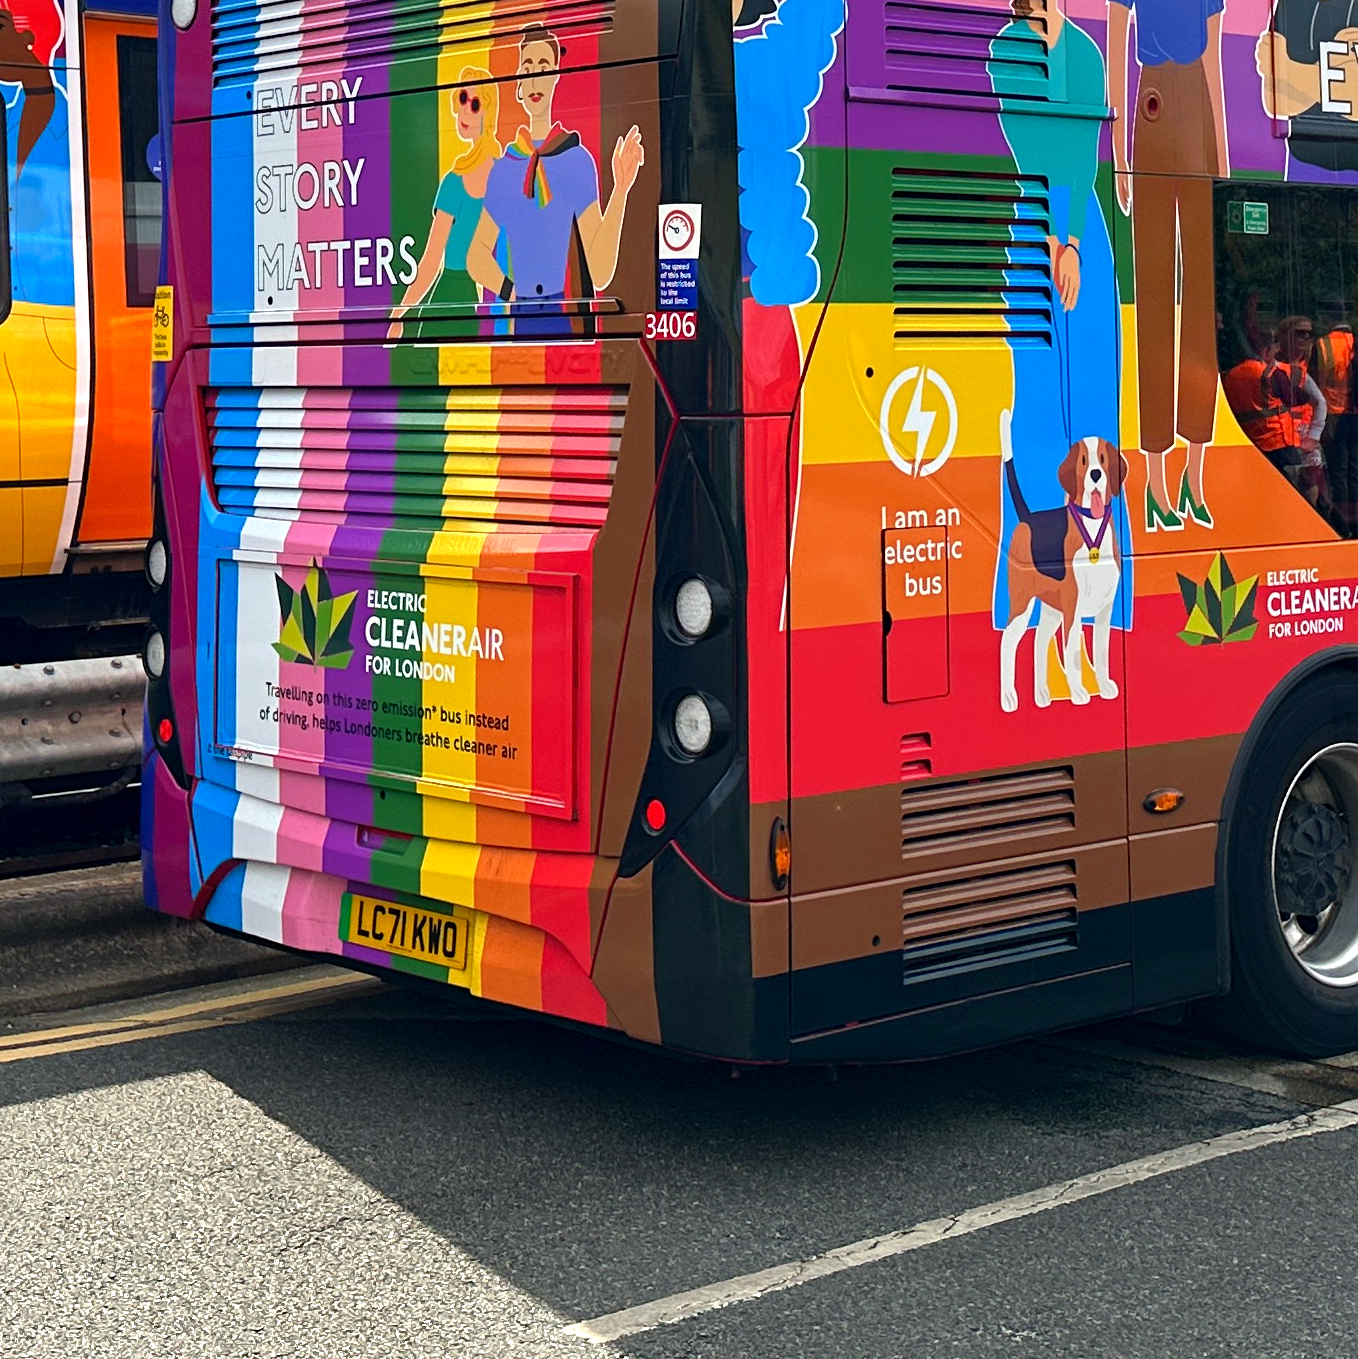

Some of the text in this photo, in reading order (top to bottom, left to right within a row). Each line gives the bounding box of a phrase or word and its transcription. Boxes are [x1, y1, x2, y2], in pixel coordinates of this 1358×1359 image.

[256, 76, 363, 137] EVERY
[255, 157, 366, 215] STORY
[257, 235, 419, 292] MATTERS
[660, 262, 690, 272] The speed
[660, 271, 692, 279] of this bus
[660, 280, 696, 288] is restricted
[660, 288, 679, 297] to the
[660, 297, 674, 305] local
[645, 311, 696, 339] 3406
[881, 506, 960, 530] I am an
[884, 536, 963, 565] electric
[905, 572, 943, 597] bus
[1266, 567, 1319, 587] ELECTRIC
[367, 589, 428, 613] ELECTRIC
[1268, 616, 1344, 640] FOR LONDON
[365, 654, 456, 684] FOR LONDON
[265, 681, 314, 707] Travelling
[316, 692, 330, 706] on
[332, 691, 353, 709] this
[355, 697, 379, 713] zero
[440, 704, 462, 725] bus
[464, 709, 510, 732] instead
[259, 705, 272, 721] of
[312, 712, 341, 734] helps
[343, 718, 403, 742] Londoners
[405, 727, 451, 750] breathe
[453, 735, 498, 757] cleaner
[501, 742, 518, 761] air
[357, 900, 458, 959] LC71 KWO
